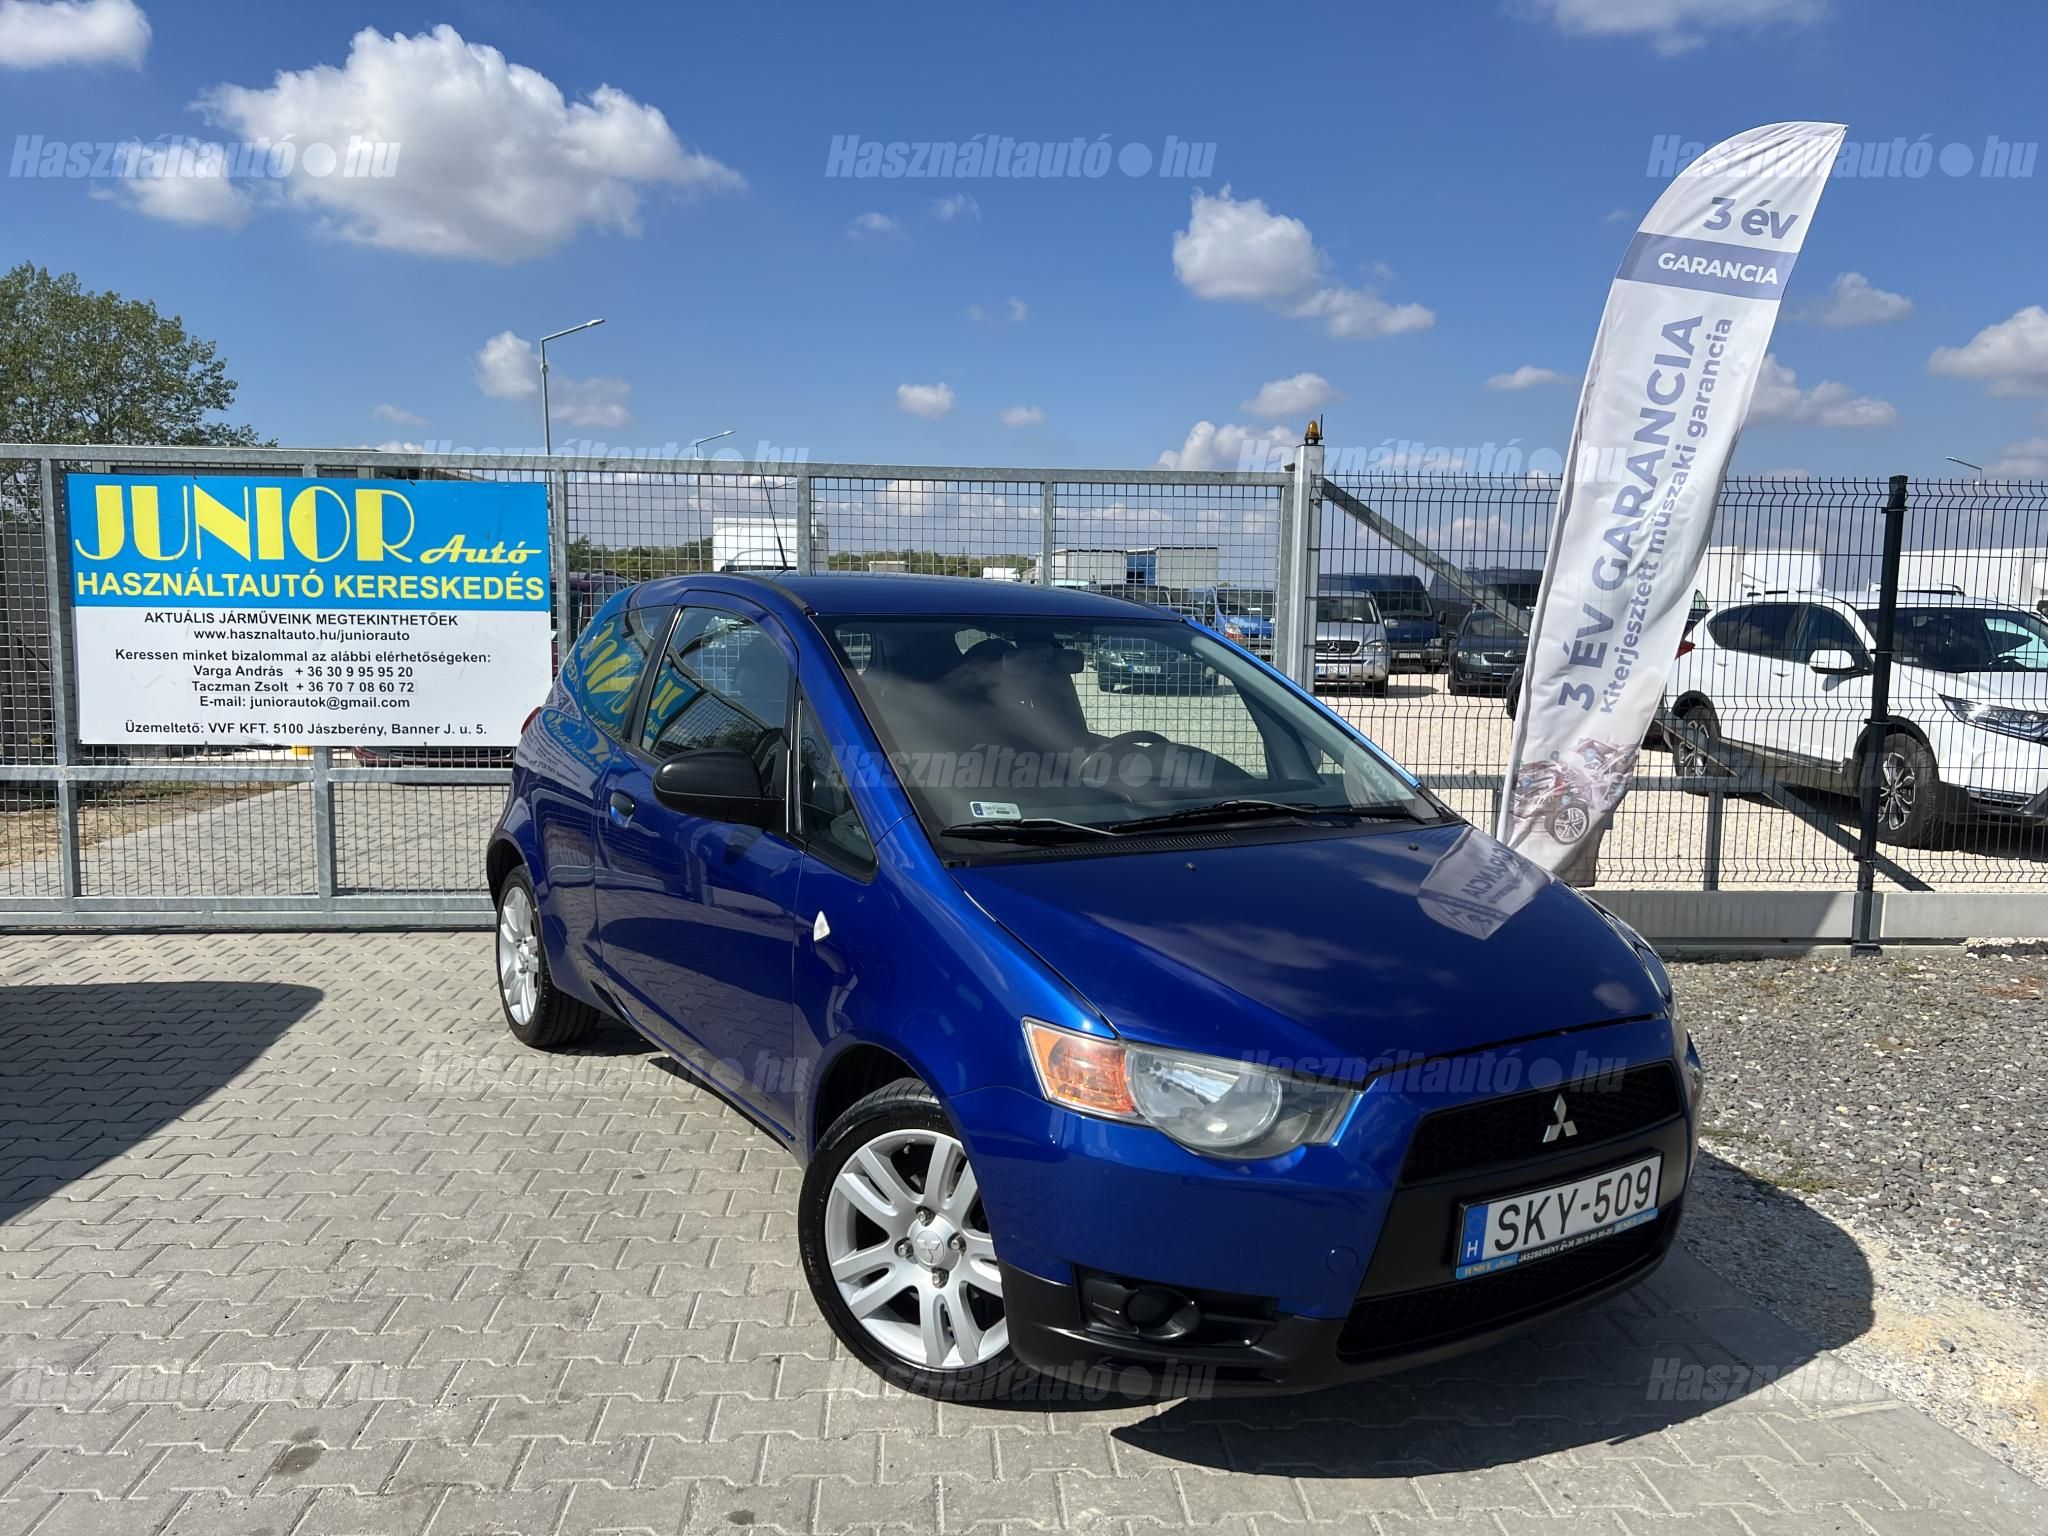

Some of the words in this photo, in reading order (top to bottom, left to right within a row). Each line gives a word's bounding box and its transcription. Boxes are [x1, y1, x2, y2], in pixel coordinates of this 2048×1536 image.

[1703, 197, 1736, 231] 3
[1741, 200, 1799, 239] év
[1658, 252, 1778, 285] GARANCIA
[1687, 319, 1733, 438] garancia
[1592, 316, 1704, 592] GARANCIA
[75, 484, 415, 564] JUNIOR
[420, 534, 542, 564] Autó
[77, 567, 324, 599] HASZNÁLTAUTÓ
[334, 571, 545, 600] KERESKEDÉS
[144, 610, 215, 624] AKTUÁLIS
[219, 610, 312, 625] JÁRMŰVEINK
[316, 611, 459, 626] MEGTEKINTHETŐEK
[193, 629, 410, 643] www.hasznaltauto.hu/juniorauto
[1563, 603, 1615, 668] ÉV
[115, 649, 178, 661] Keressen
[182, 650, 228, 661] minket
[231, 650, 308, 662] bizalommal
[312, 652, 327, 662] az
[330, 651, 371, 662] alábbi
[375, 651, 491, 665] elérhetőségeken:
[193, 665, 232, 679] Varga
[235, 665, 284, 677] András
[307, 666, 323, 677] 36
[327, 666, 342, 677] 30
[346, 666, 354, 677] 9
[358, 666, 374, 677] 95
[378, 667, 394, 677] 95
[397, 667, 413, 678] 20
[191, 681, 251, 692] Taczman
[254, 681, 289, 692] Zsolt
[308, 682, 324, 692] 36
[327, 682, 343, 693] 70
[347, 682, 355, 693] 7
[359, 682, 375, 693] 08
[379, 682, 395, 693] 60
[399, 682, 414, 693] 72
[1558, 682, 1595, 711] 3
[199, 696, 246, 707] E-mail:
[249, 696, 410, 710] juniorautok@gmail.com
[208, 723, 235, 734] VVF
[239, 723, 269, 734] KFT.
[273, 723, 304, 734] 5100
[307, 723, 387, 737] Jászberény,
[391, 724, 440, 735] Banner
[443, 724, 455, 735] J.
[459, 726, 472, 735] u.
[475, 724, 487, 735] 5.
[1494, 1165, 1651, 1252] SKY-509
[1466, 1240, 1479, 1258] H
